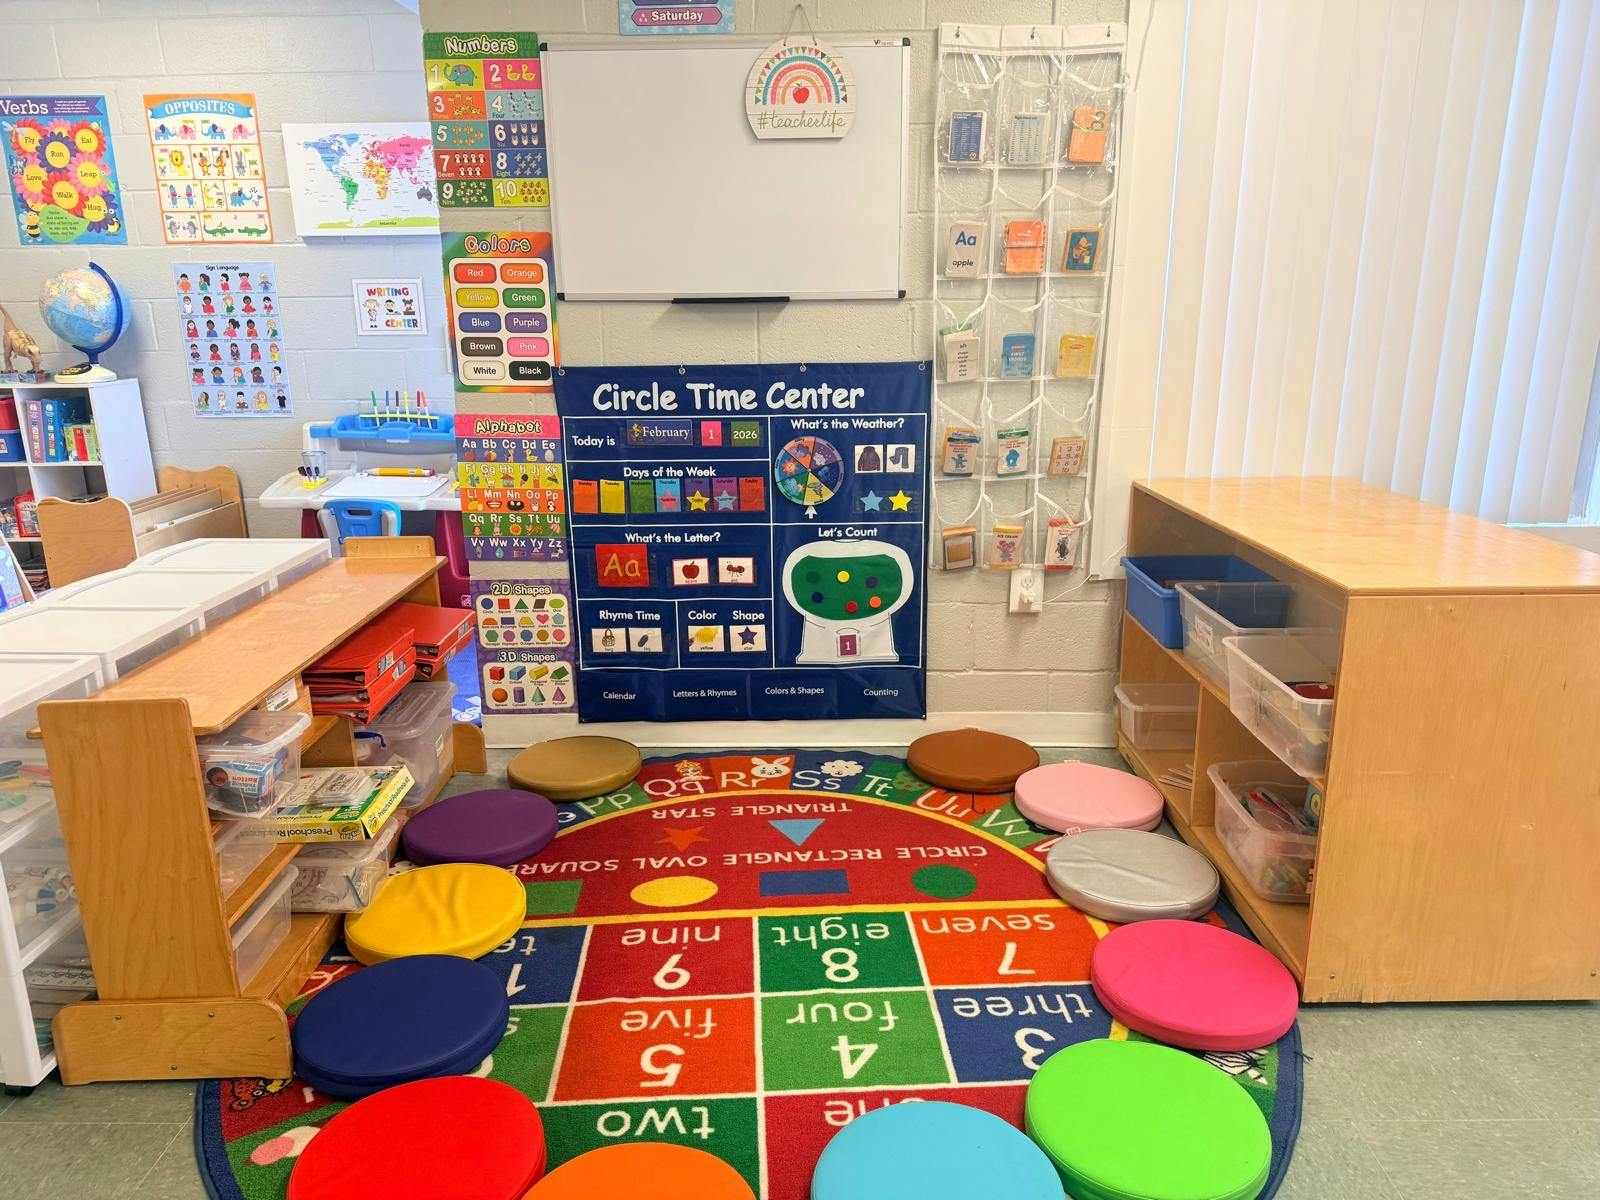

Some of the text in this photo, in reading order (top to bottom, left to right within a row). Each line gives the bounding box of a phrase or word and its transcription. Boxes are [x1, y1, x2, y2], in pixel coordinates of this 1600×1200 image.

[651, 10, 703, 22] Saturday
[445, 36, 517, 54] Numbers
[430, 64, 439, 82] 1
[489, 64, 502, 82] 2
[0, 100, 49, 115] Verbs
[164, 99, 236, 115] OPPOSITES
[433, 96, 445, 113] 3
[492, 95, 503, 112] 4
[757, 109, 845, 134] #teacherlife
[24, 136, 35, 145] Fly
[81, 136, 92, 144] Eat
[436, 125, 448, 142] 5
[494, 124, 507, 142] 6
[440, 155, 450, 172] 7
[496, 152, 507, 170] 8
[80, 170, 97, 179] Leap
[496, 170, 511, 178] Eight
[56, 191, 74, 199] Walk
[442, 182, 454, 199] 9
[495, 180, 517, 198] 10
[87, 204, 101, 212] Hug
[464, 234, 531, 254] Colors
[955, 231, 977, 246] Aa
[205, 264, 240, 272] Sign Language
[952, 259, 974, 268] apple
[467, 268, 484, 277] Red
[507, 269, 538, 279] Orange
[366, 287, 410, 297] WRITING
[465, 293, 491, 301] Yellow
[511, 293, 537, 302] Green
[385, 318, 418, 328] CENTER
[471, 318, 490, 327] Blue
[513, 317, 540, 329] Purple
[470, 342, 496, 350] Brown
[519, 342, 537, 350] Pink
[473, 366, 497, 375] White
[519, 366, 542, 375] Black
[592, 381, 865, 411] Circle Time Center
[474, 418, 542, 434] Alphabet
[791, 417, 905, 429] What's the Weather?
[463, 439, 556, 449] Aa Bb Cc Dd Ee
[572, 426, 758, 448] Today is February 1 2026
[465, 464, 558, 476] Ff Gg Hh Ii Jj Kk
[623, 466, 717, 479] Days of the Week
[467, 489, 559, 501] Ll Mm Nn Oo Pp
[469, 514, 560, 525] Qq Rr Ss Tt Uu
[625, 532, 721, 543] What's the Letter?
[818, 527, 878, 537] Let's Count
[471, 538, 562, 549] Vv Ww Xx Yy Zz
[604, 553, 641, 577] Aa
[491, 583, 552, 597] 2D Shapes
[599, 610, 661, 621] Rhyme Time
[688, 610, 717, 620] Color
[732, 610, 765, 621] Shape
[845, 641, 851, 650] 1
[500, 651, 556, 664] 3D Shapes
[603, 691, 636, 700] Calendar
[673, 690, 698, 698] Letters
[707, 689, 737, 698] Rhymes
[765, 687, 789, 695] Colors
[797, 687, 825, 696] Shapes
[863, 689, 899, 697] Counting
[720, 771, 767, 789] Rr
[792, 770, 842, 791] Ss
[861, 774, 894, 797] Tt
[644, 778, 705, 798] Qq
[652, 802, 852, 819] TRIANGLE STAR
[916, 790, 972, 819] Uu
[287, 828, 332, 838] Preschool
[723, 847, 883, 865] RECTANGLE
[897, 845, 988, 858] CIRCLE
[633, 855, 708, 870] OVAL
[922, 914, 1055, 934] seven
[621, 925, 721, 949] nine
[772, 917, 890, 950] eight
[493, 935, 537, 956] te
[821, 948, 859, 983] 8
[998, 942, 1036, 975] 7
[653, 953, 691, 990] 9
[506, 963, 528, 997] 1
[786, 1000, 899, 1031] four
[953, 993, 1093, 1023] three
[620, 1008, 717, 1039] five
[1014, 1027, 1055, 1071] 3
[831, 1035, 879, 1079] 4
[640, 1044, 685, 1087] 5
[597, 1106, 715, 1140] two
